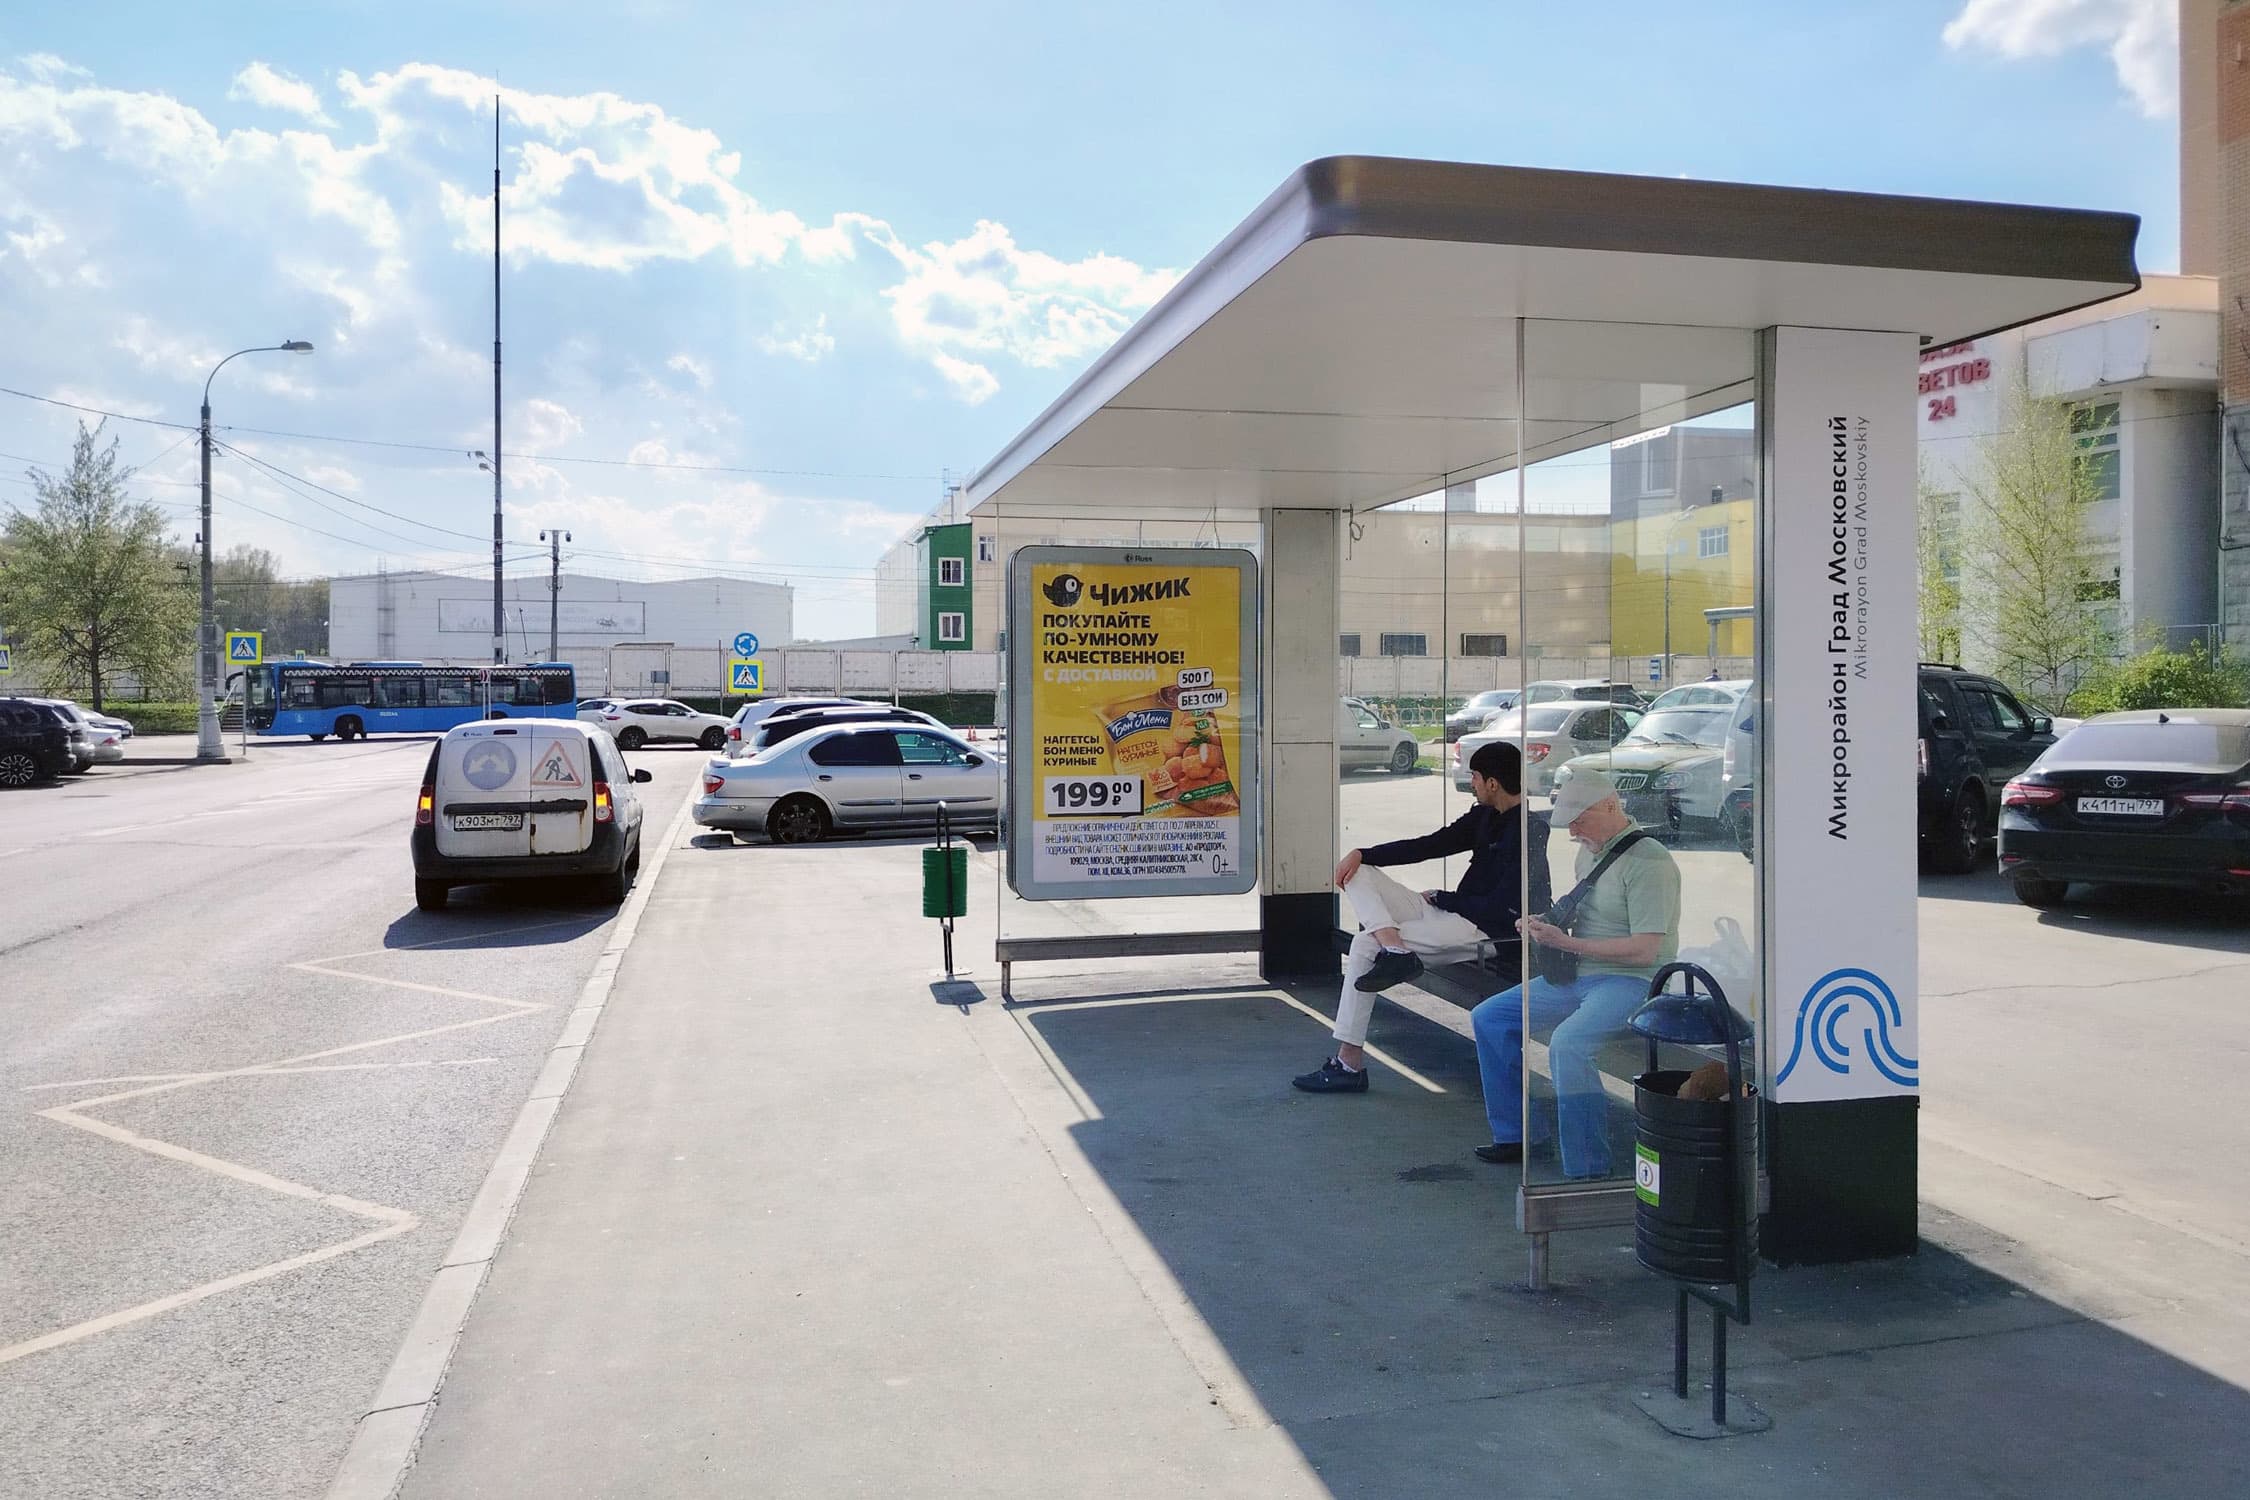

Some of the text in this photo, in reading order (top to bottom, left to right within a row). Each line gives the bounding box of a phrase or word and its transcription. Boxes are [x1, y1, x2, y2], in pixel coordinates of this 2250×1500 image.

[1919, 359, 1990, 394] ВЕТОВ
[1928, 396, 1955, 421] 24
[1854, 416, 1870, 679] Mikrorayon Grad Moskovskiy
[1090, 577, 1191, 606] Чижик
[1043, 612, 1151, 628] ПОКУПАЙТЕ
[1828, 416, 1851, 840] Микрорайон Град Московский
[1043, 633, 1159, 646] ПО-УМНОМУ
[1043, 651, 1185, 664] КАЧЕСТВЕННОЕ!
[1044, 667, 1157, 684] С ДОСТАВКОЙ
[1182, 672, 1201, 683] 500
[1181, 692, 1223, 706] БЕЗ СОИ
[1112, 712, 1169, 736] Бон Меню
[1043, 736, 1099, 744] НАГГЕТСЫ
[1043, 746, 1104, 755] БОН МЕНЮ
[1043, 757, 1097, 766] КУРИНЫЕ
[1051, 782, 1132, 807] 199 00
[2137, 800, 2160, 809] 797
[503, 815, 519, 824] 797
